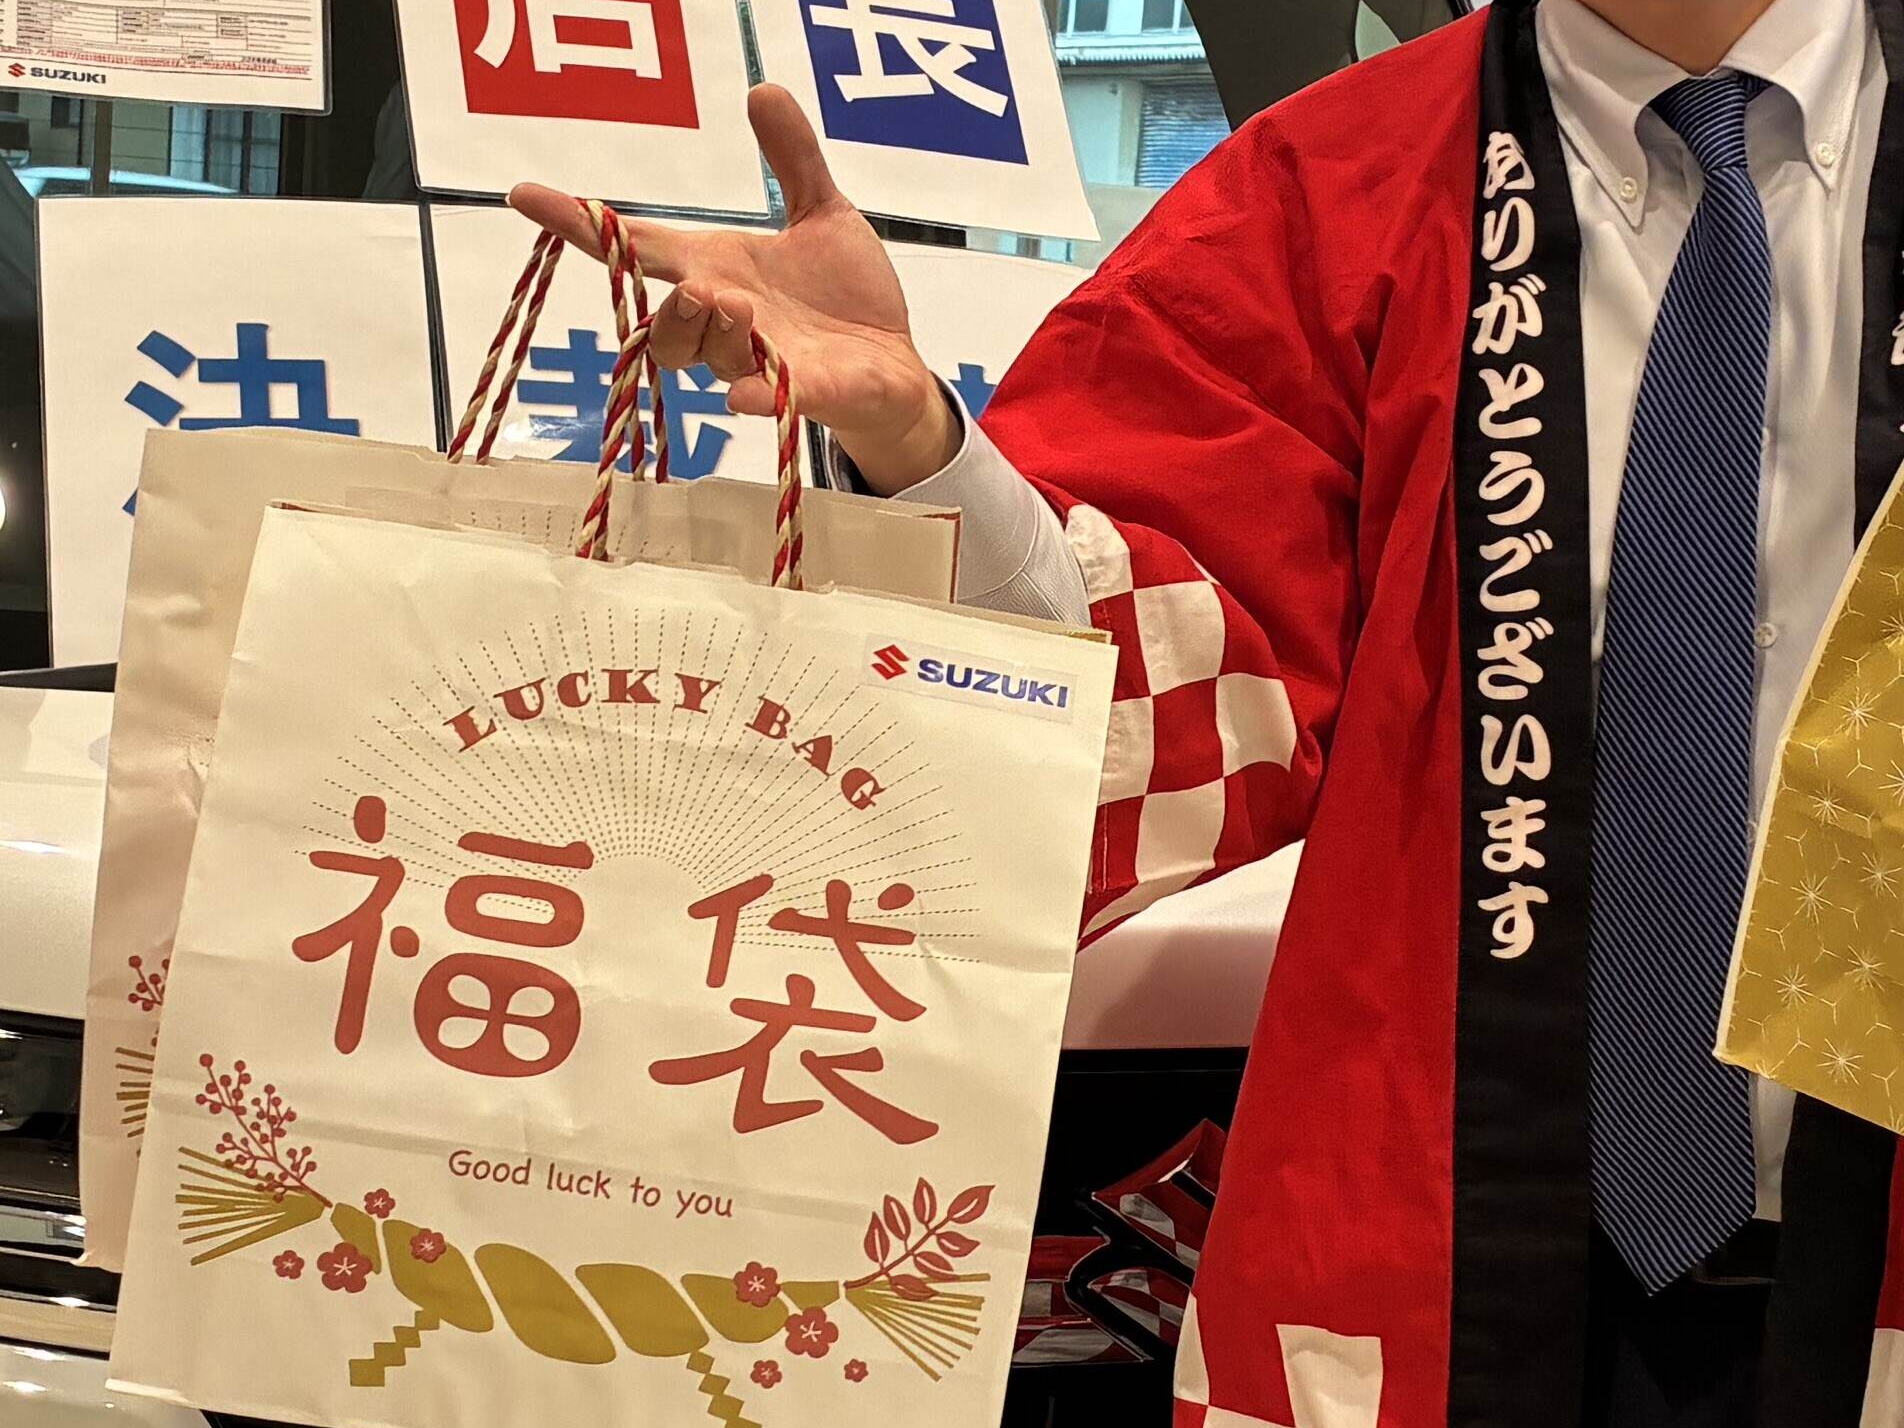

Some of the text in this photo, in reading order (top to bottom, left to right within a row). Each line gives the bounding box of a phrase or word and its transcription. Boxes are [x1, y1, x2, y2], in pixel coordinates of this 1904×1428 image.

[31, 66, 107, 85] SUZUKI
[1472, 130, 1554, 960] ありがとうございます
[915, 657, 1069, 709] SUZUKI
[442, 667, 887, 811] LUCKY BAG
[290, 794, 939, 1146] 福袋
[448, 1149, 734, 1220] Good luck to you
